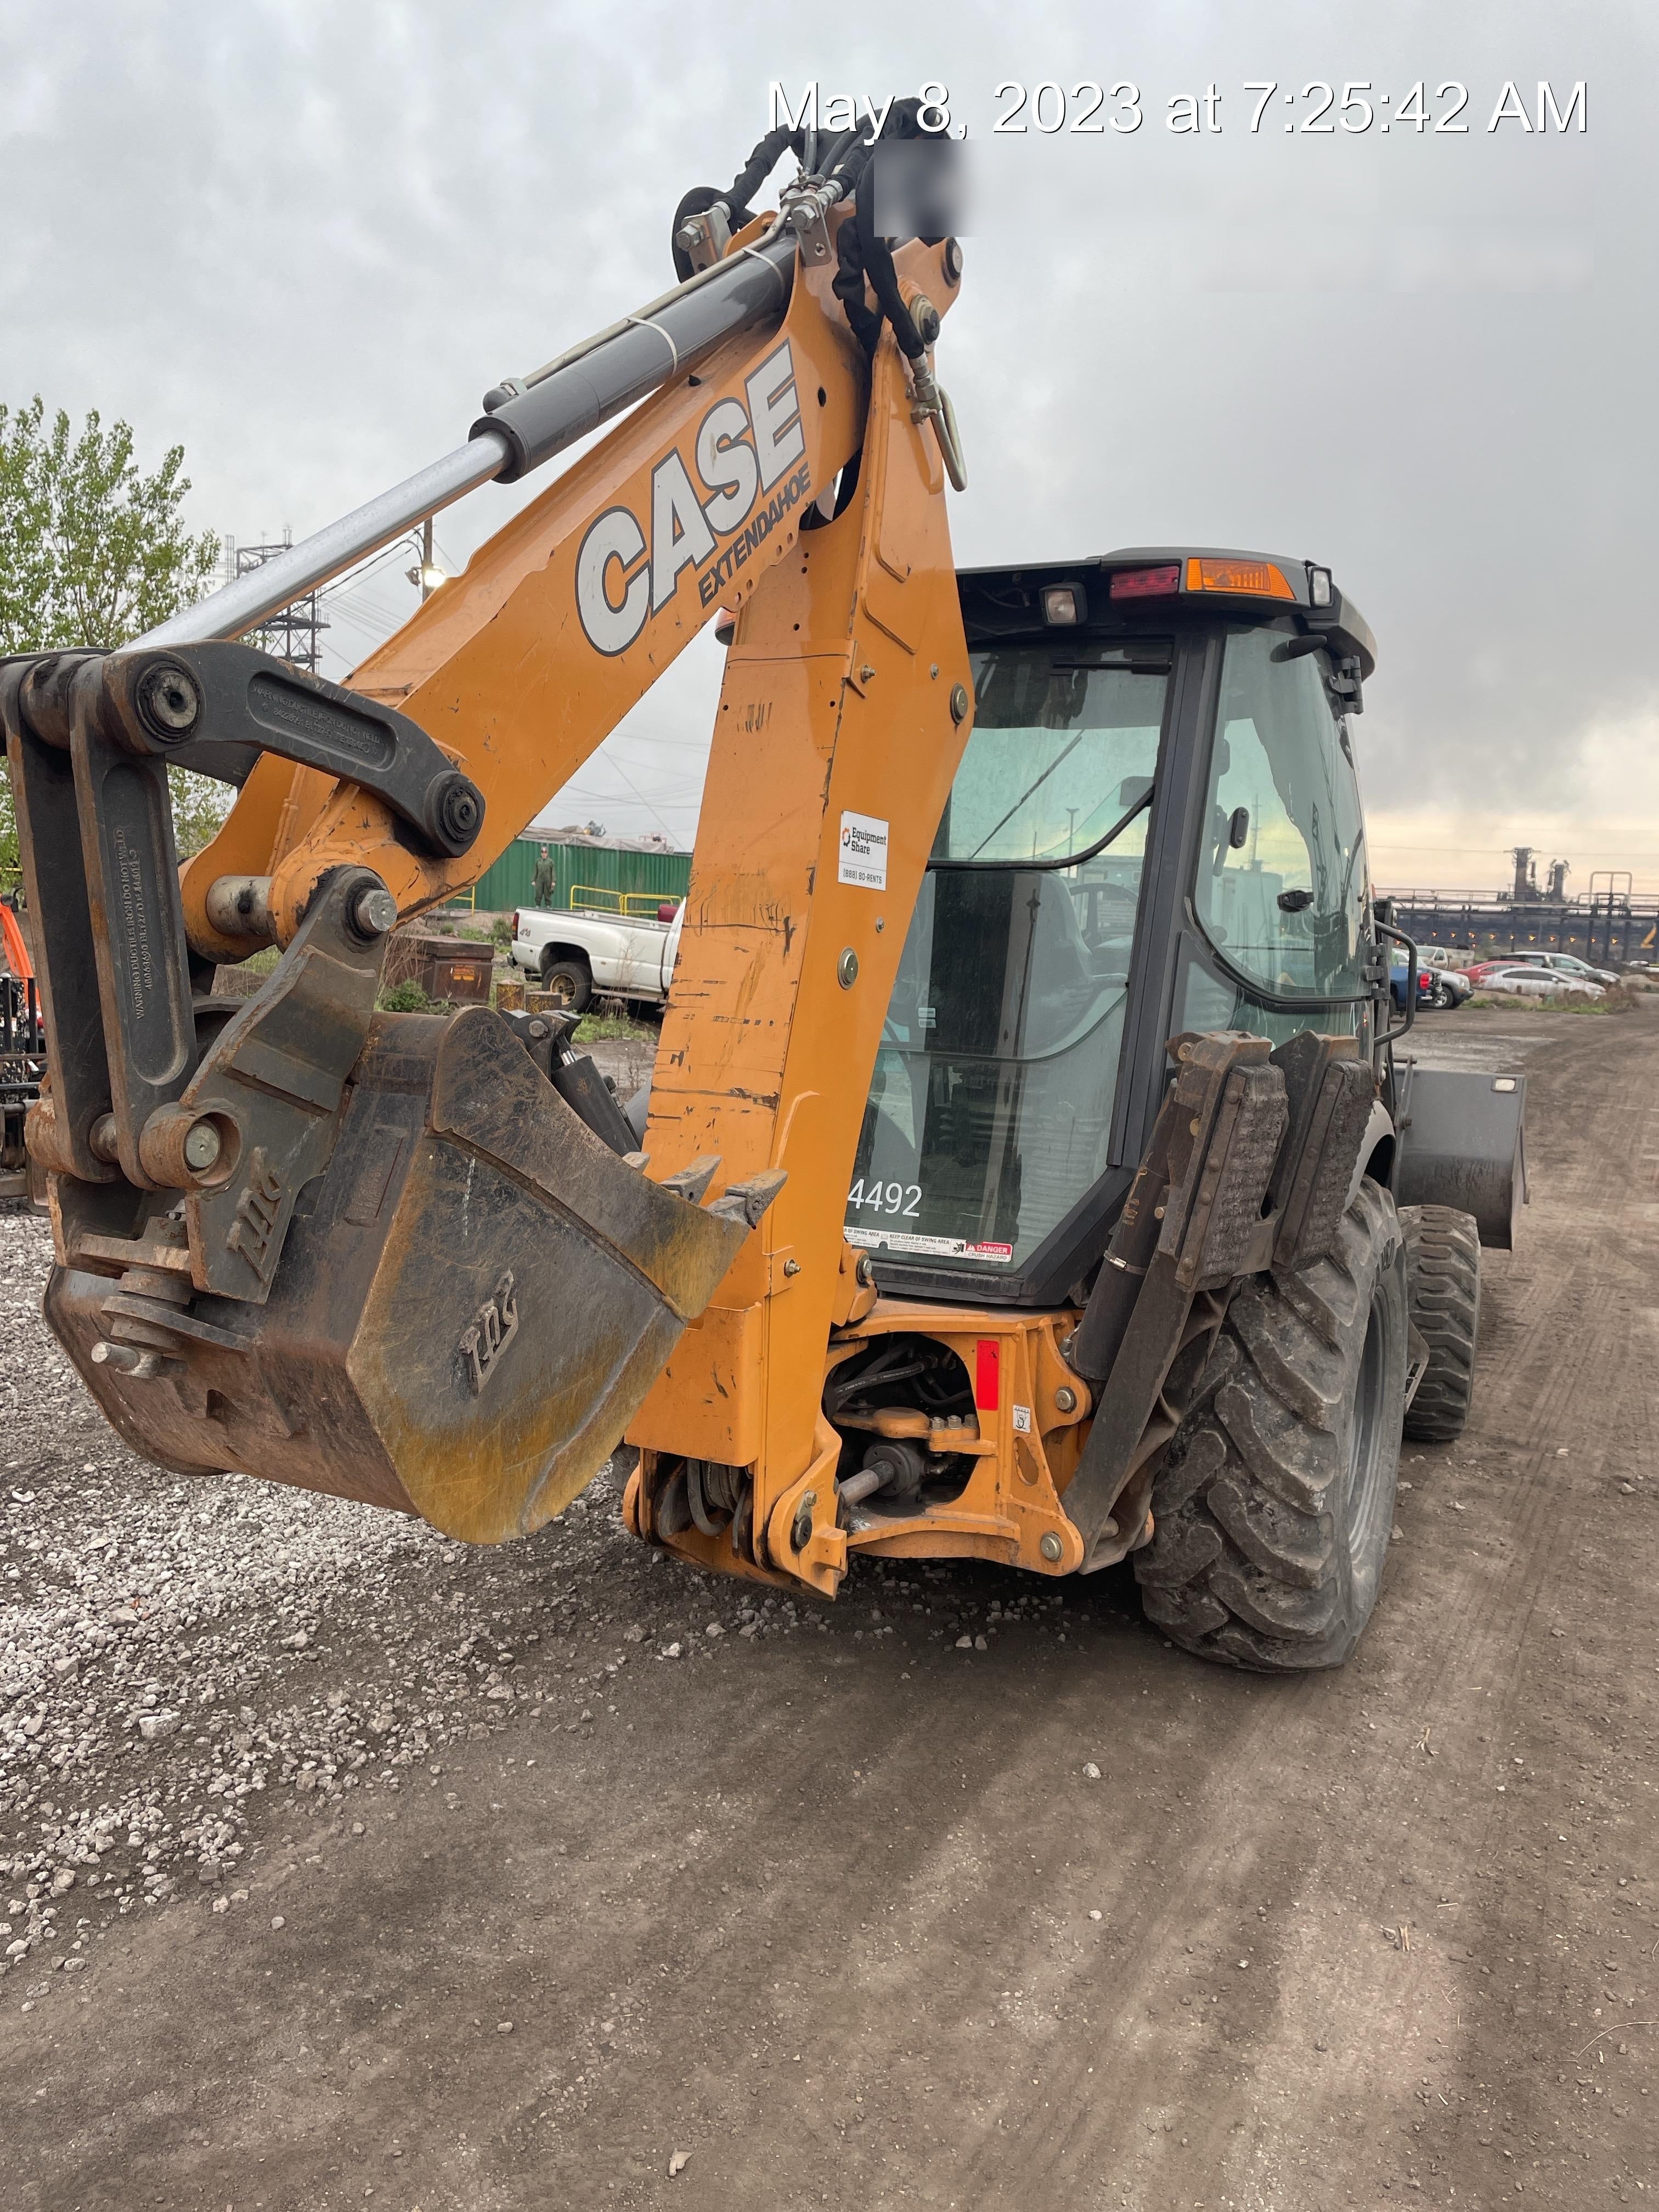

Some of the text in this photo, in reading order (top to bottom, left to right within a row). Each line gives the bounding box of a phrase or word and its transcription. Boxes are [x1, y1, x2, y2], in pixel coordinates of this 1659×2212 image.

[575, 337, 806, 657] CASE
[698, 461, 811, 608] EXTENDAHOE
[852, 827, 887, 845] Equipment
[851, 841, 871, 855] Share
[119, 862, 129, 883] NOT
[859, 871, 882, 884] 80-RENTS
[122, 884, 132, 900] DO
[124, 901, 135, 927] IRON
[127, 927, 139, 970] DUCTILE
[132, 971, 145, 1020] WARNING
[847, 1178, 923, 1217] 4492
[977, 1245, 1008, 1254] DANGER
